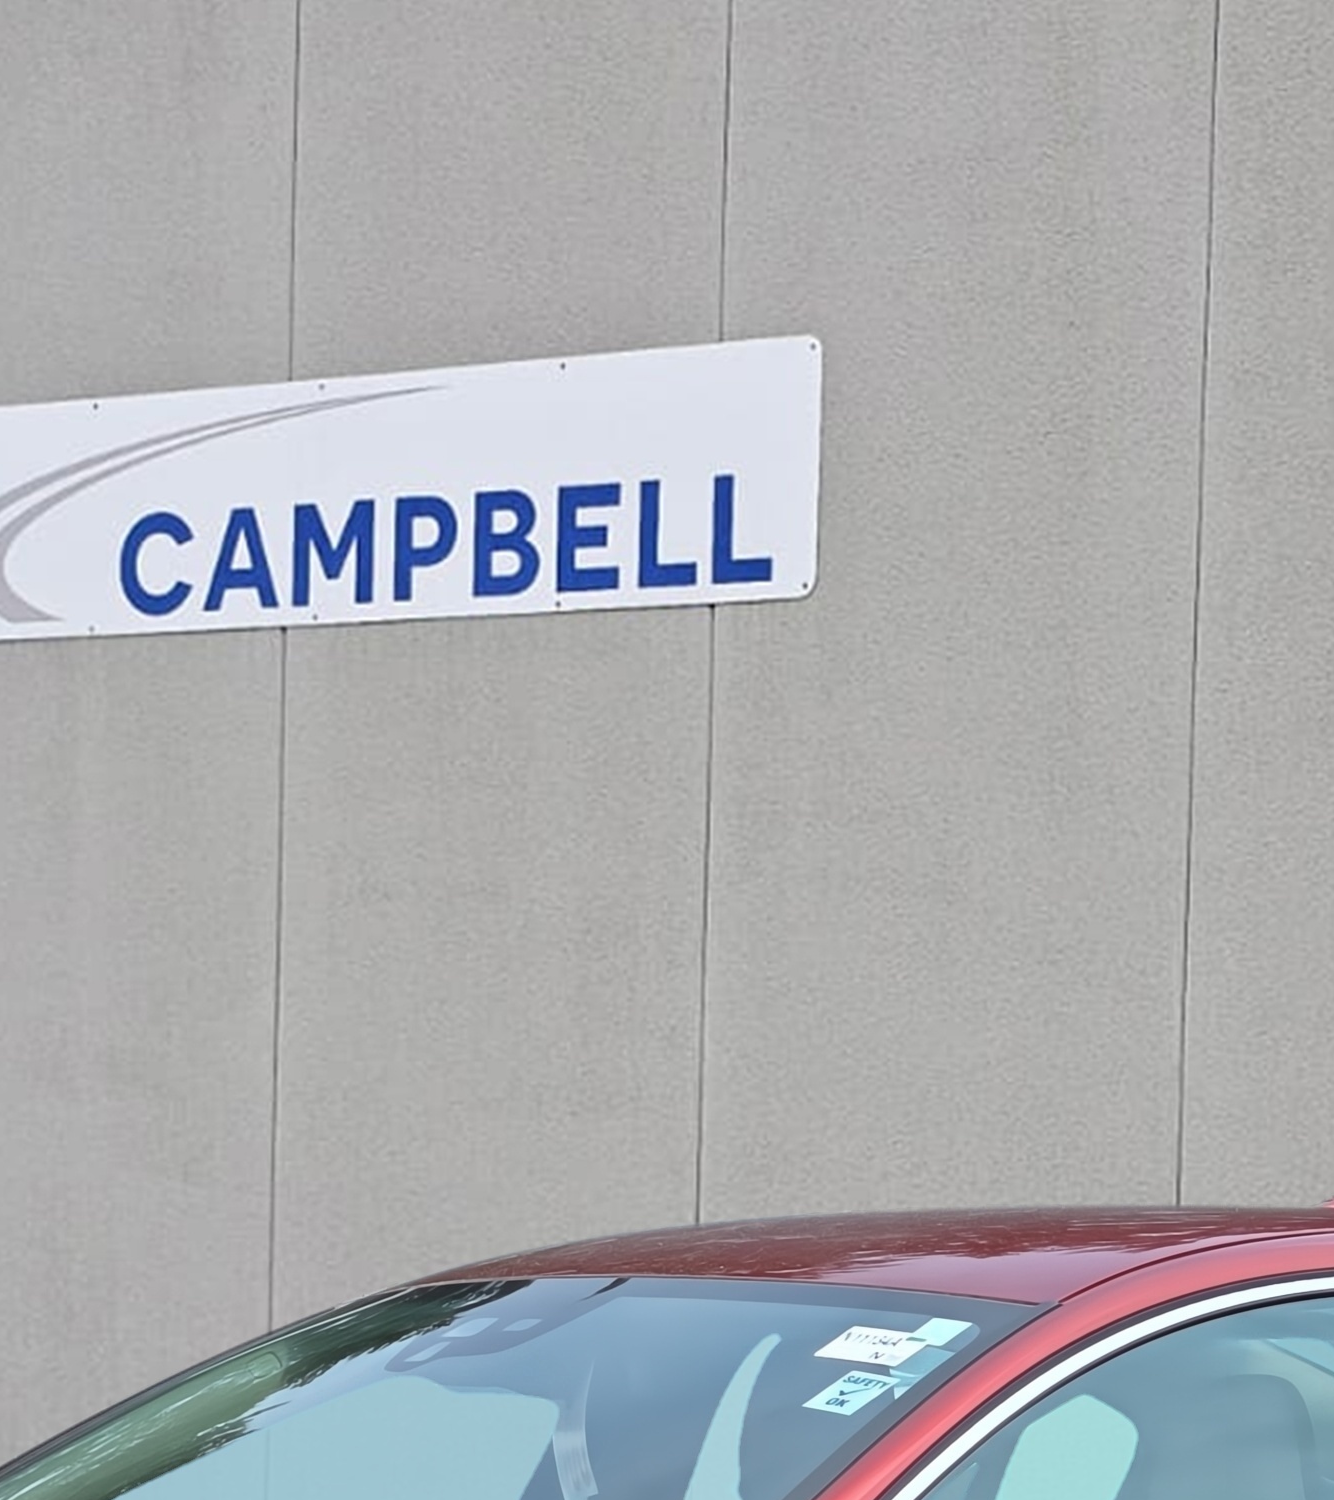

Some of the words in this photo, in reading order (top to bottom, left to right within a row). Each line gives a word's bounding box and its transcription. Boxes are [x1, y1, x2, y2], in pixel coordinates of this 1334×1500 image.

[118, 472, 774, 617] CAMPBELL
[842, 1375, 891, 1389] SAFETY
[825, 1397, 851, 1407] OK
